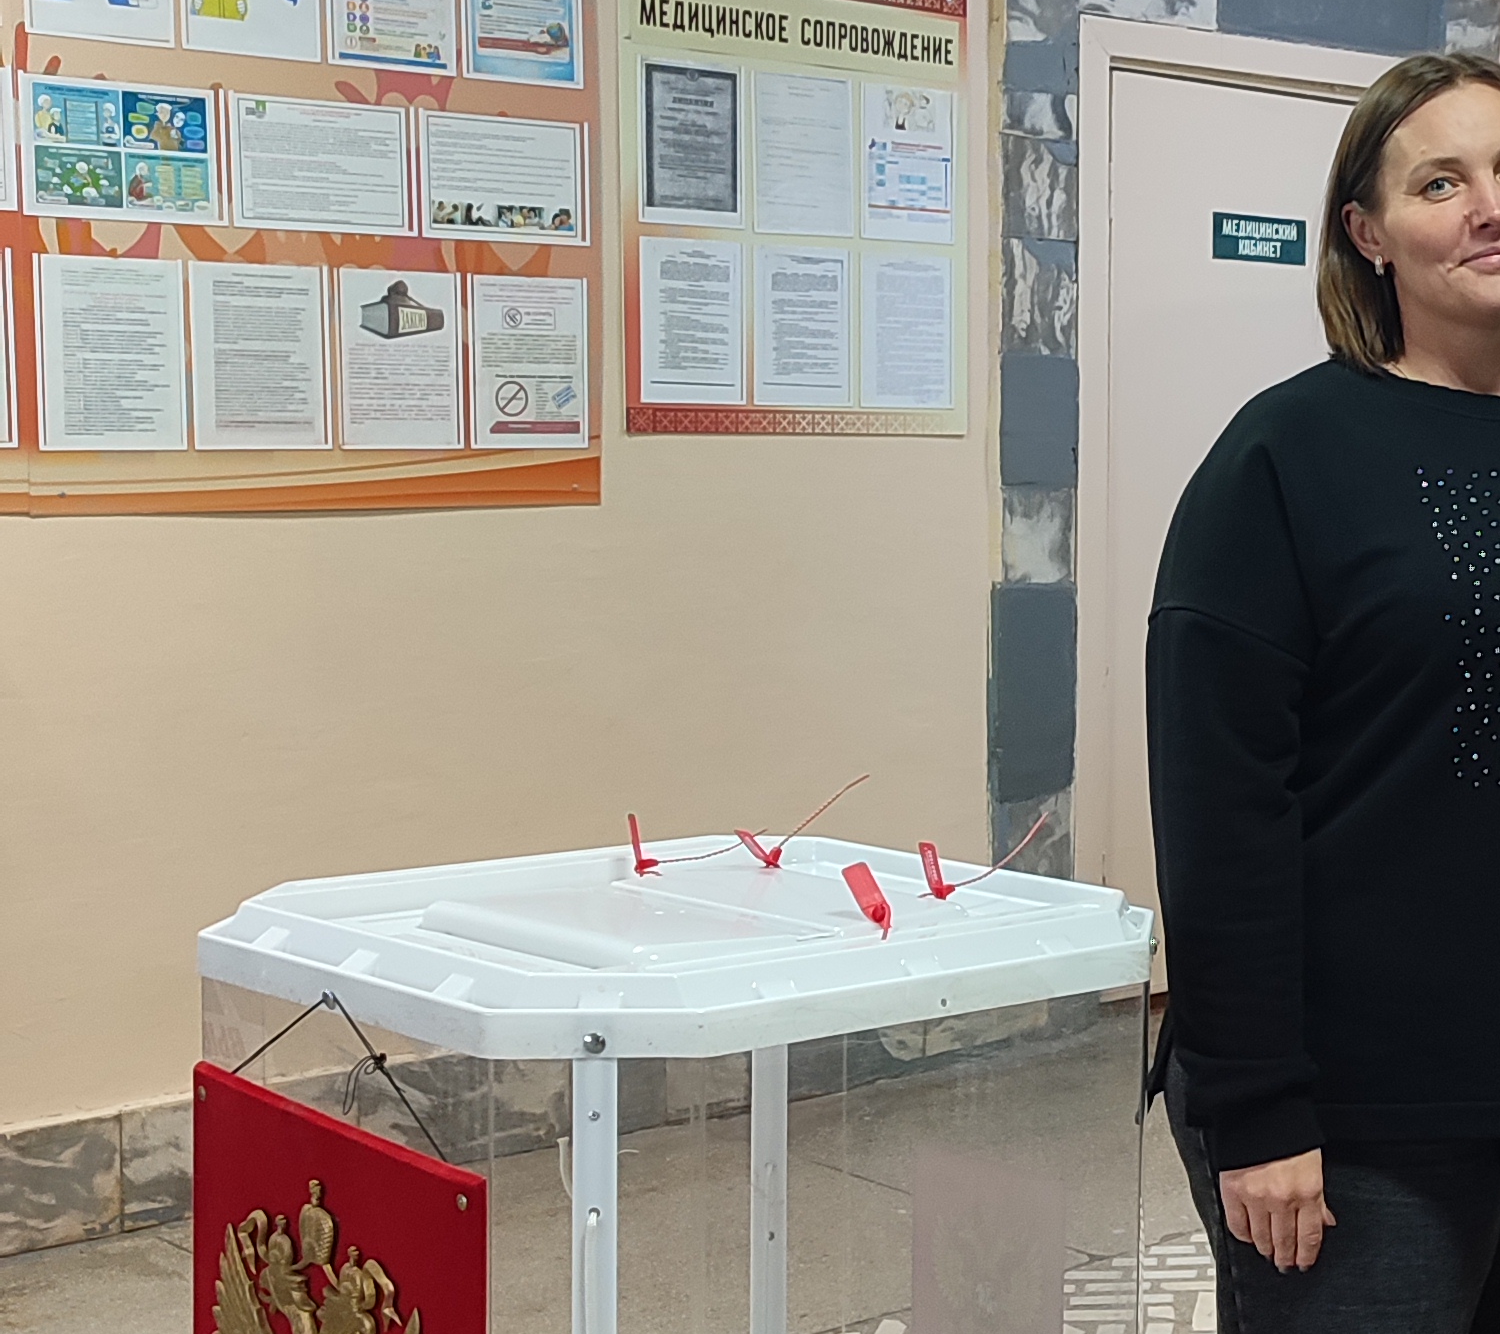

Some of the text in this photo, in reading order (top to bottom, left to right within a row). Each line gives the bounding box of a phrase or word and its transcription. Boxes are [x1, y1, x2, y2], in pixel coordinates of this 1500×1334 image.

[801, 18, 954, 66] СОПРОВОЖДЕНИЕ
[1221, 218, 1298, 242] МЕДИЦИНСКИЙ
[1237, 238, 1281, 259] КАБИНЕТ
